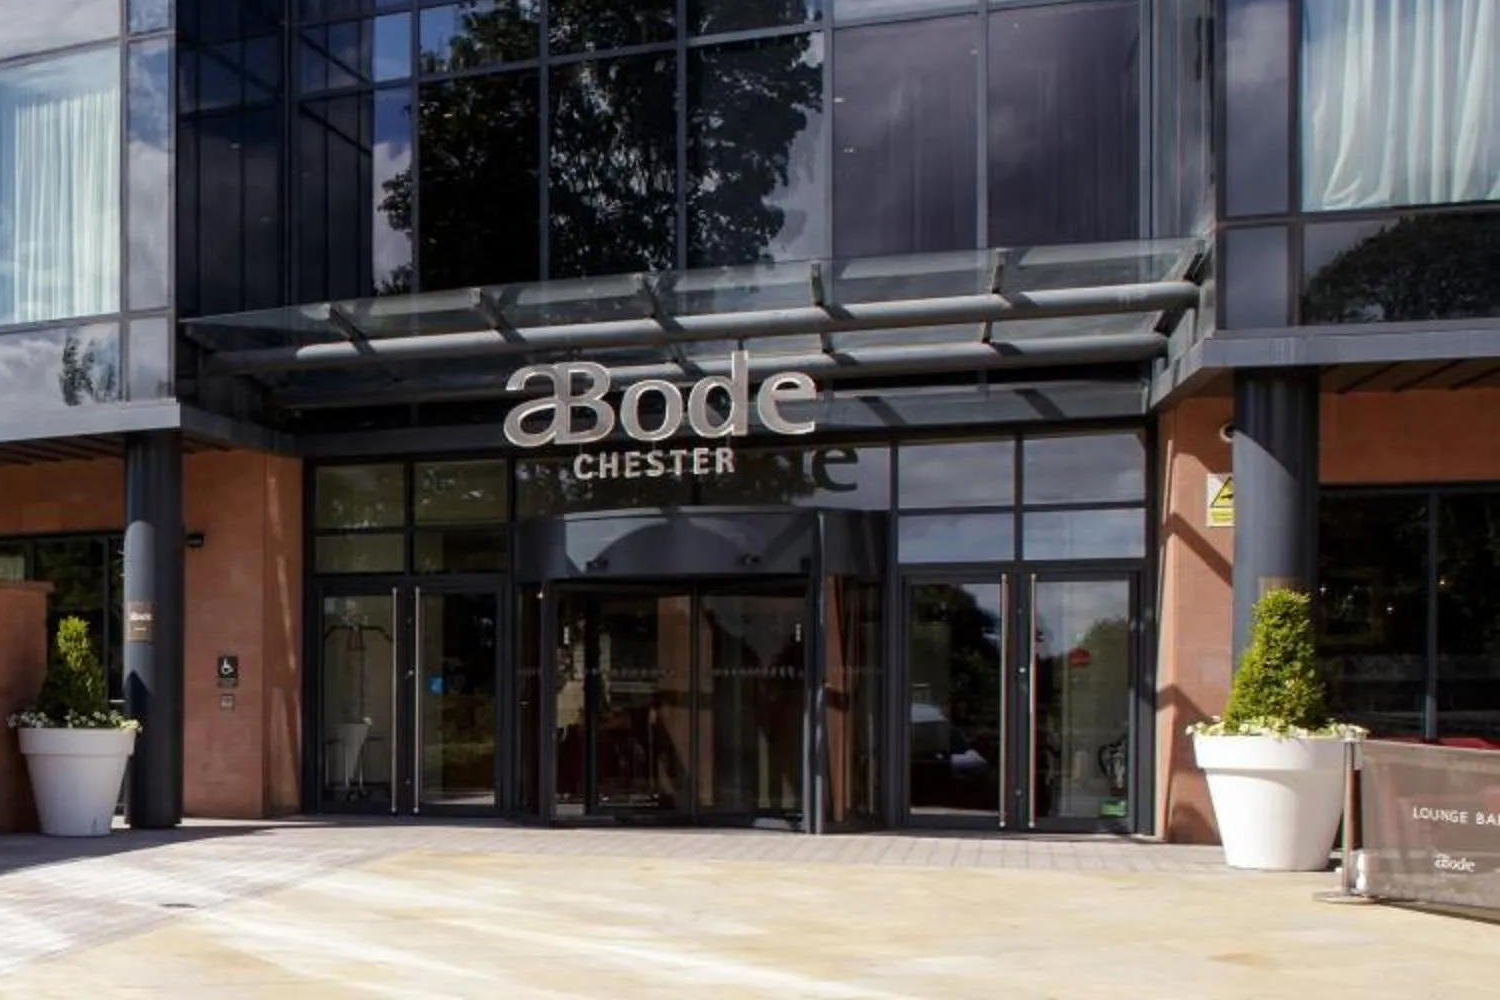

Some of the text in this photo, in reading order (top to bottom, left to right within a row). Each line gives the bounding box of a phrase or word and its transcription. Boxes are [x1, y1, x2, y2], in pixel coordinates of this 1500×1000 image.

[503, 350, 817, 447] aBode
[574, 447, 735, 480] CHESTER
[1412, 806, 1469, 825] LOUNGE
